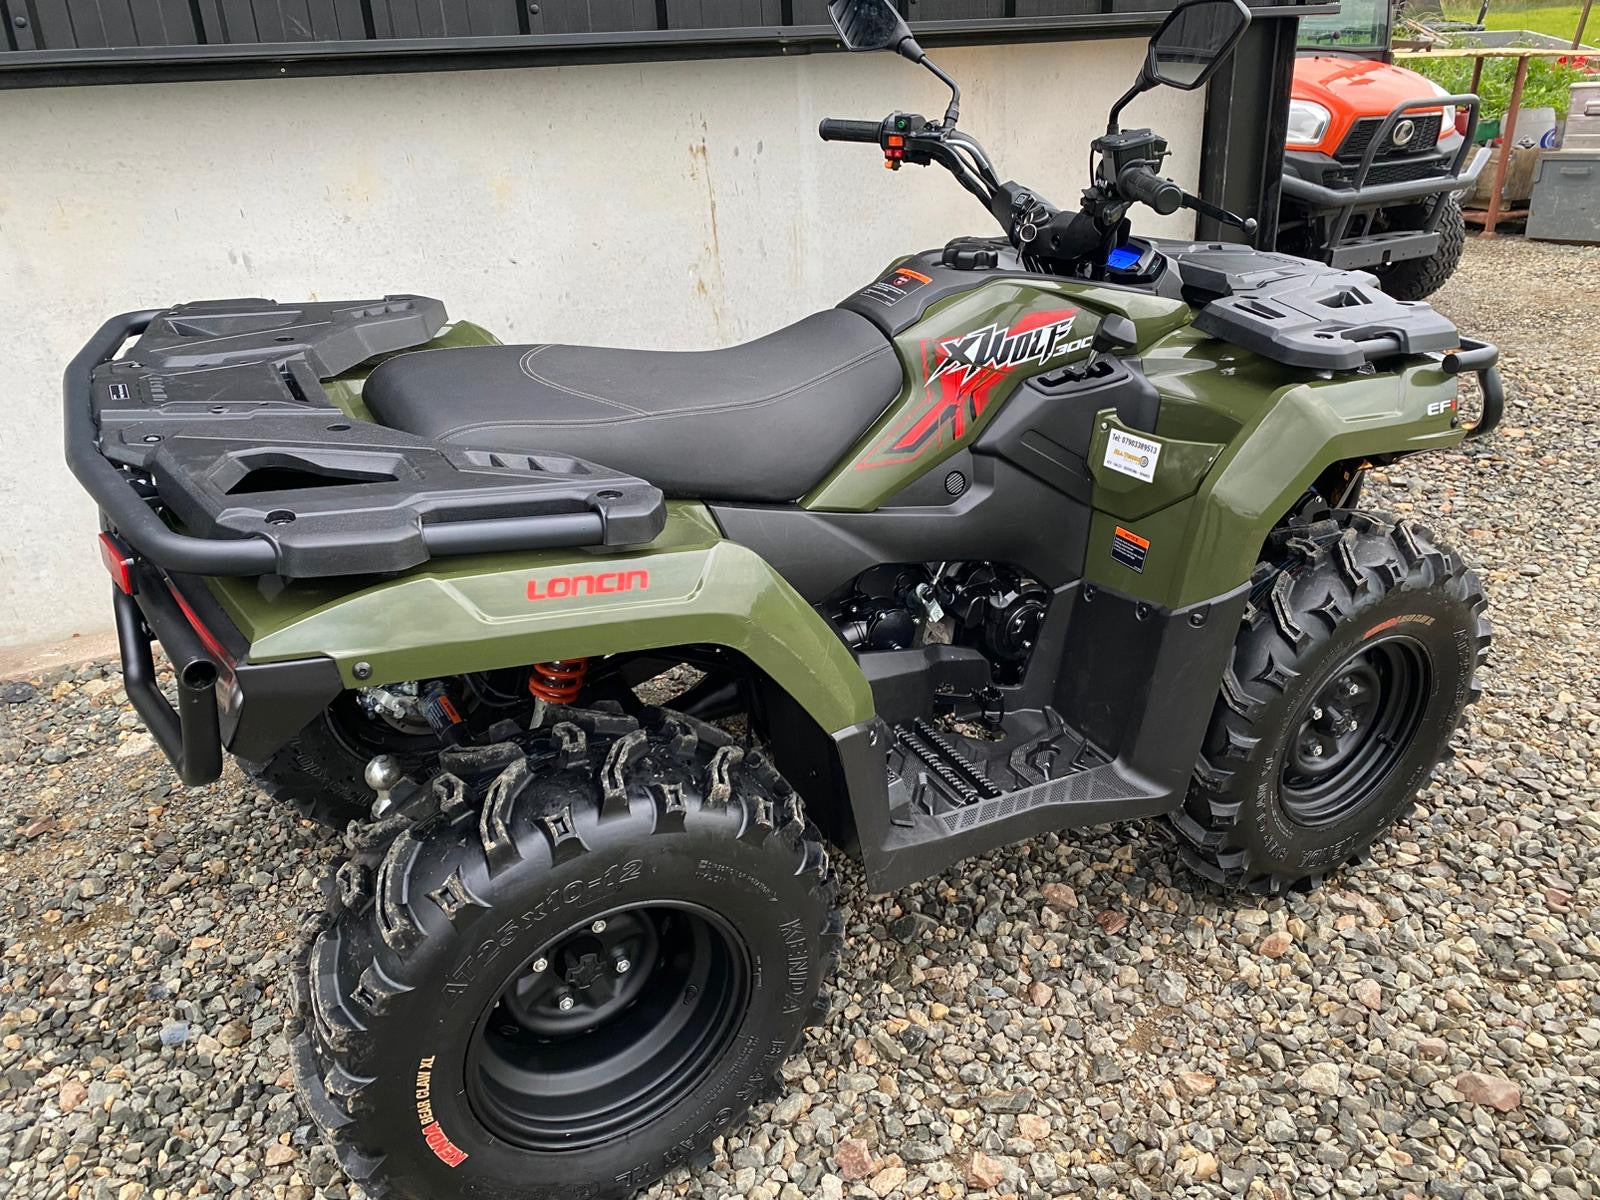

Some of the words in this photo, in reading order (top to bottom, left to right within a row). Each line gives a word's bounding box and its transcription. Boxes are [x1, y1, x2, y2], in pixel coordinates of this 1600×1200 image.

[527, 570, 649, 600] LONCIN
[778, 918, 809, 1014] KENDA
[419, 1055, 436, 1069] XL
[415, 1071, 431, 1099] CLAW
[416, 1099, 434, 1126] BEAR
[422, 1121, 469, 1168] KENDA
